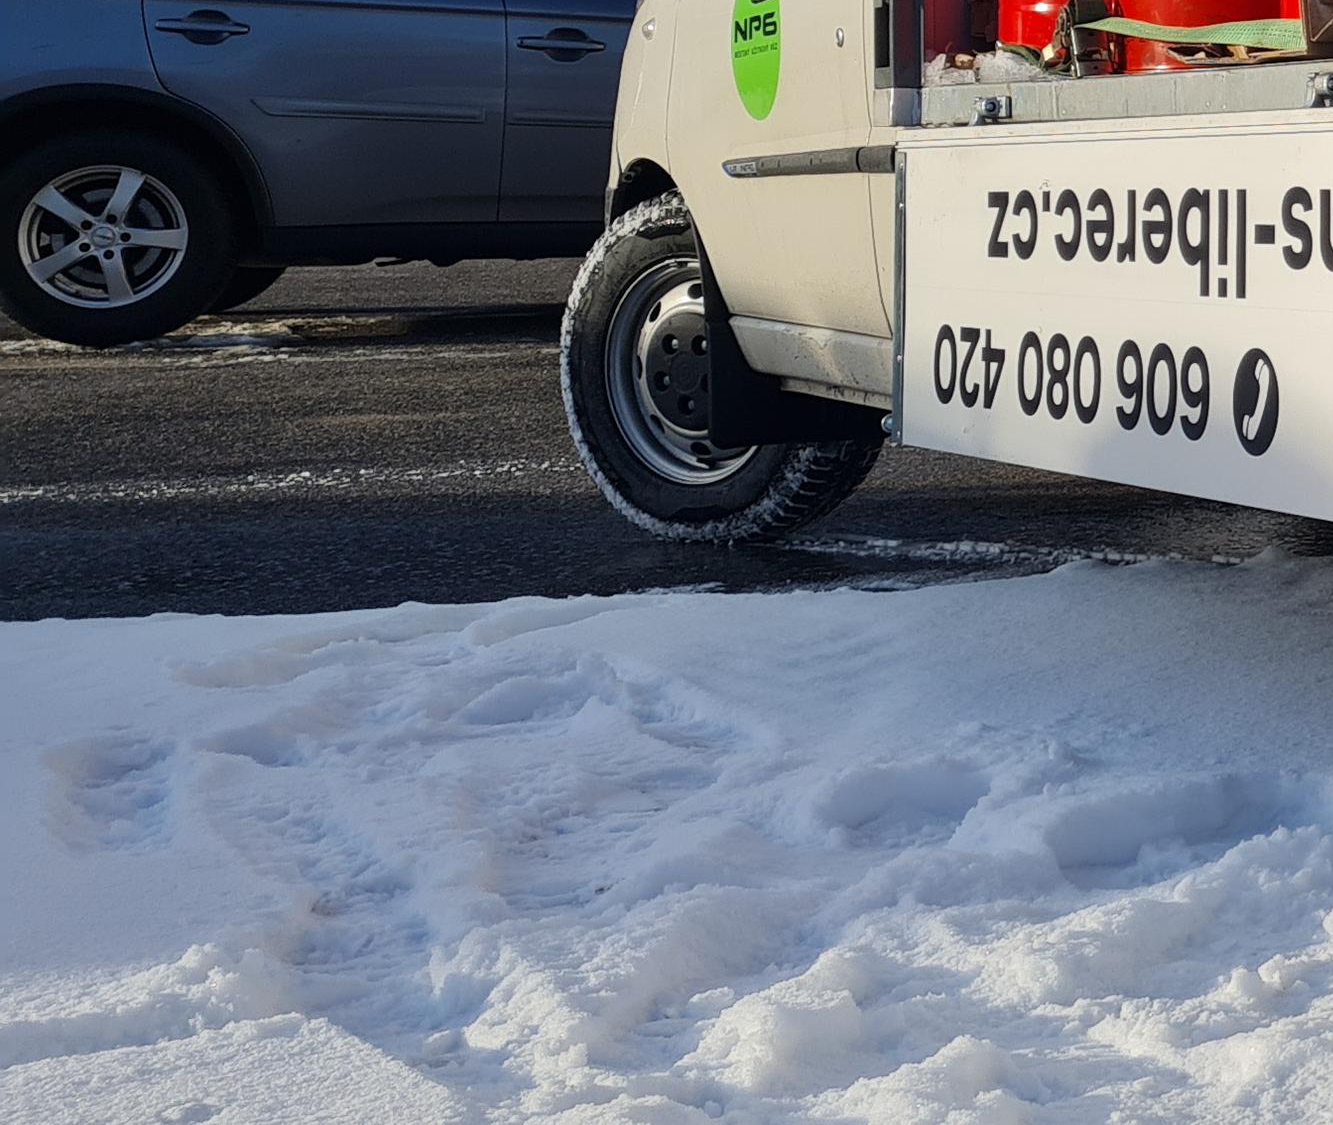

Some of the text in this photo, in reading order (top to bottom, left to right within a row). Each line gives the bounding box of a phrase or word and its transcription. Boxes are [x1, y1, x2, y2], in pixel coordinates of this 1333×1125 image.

[734, 11, 778, 44] NP6
[933, 323, 1210, 442] 606 080 420
